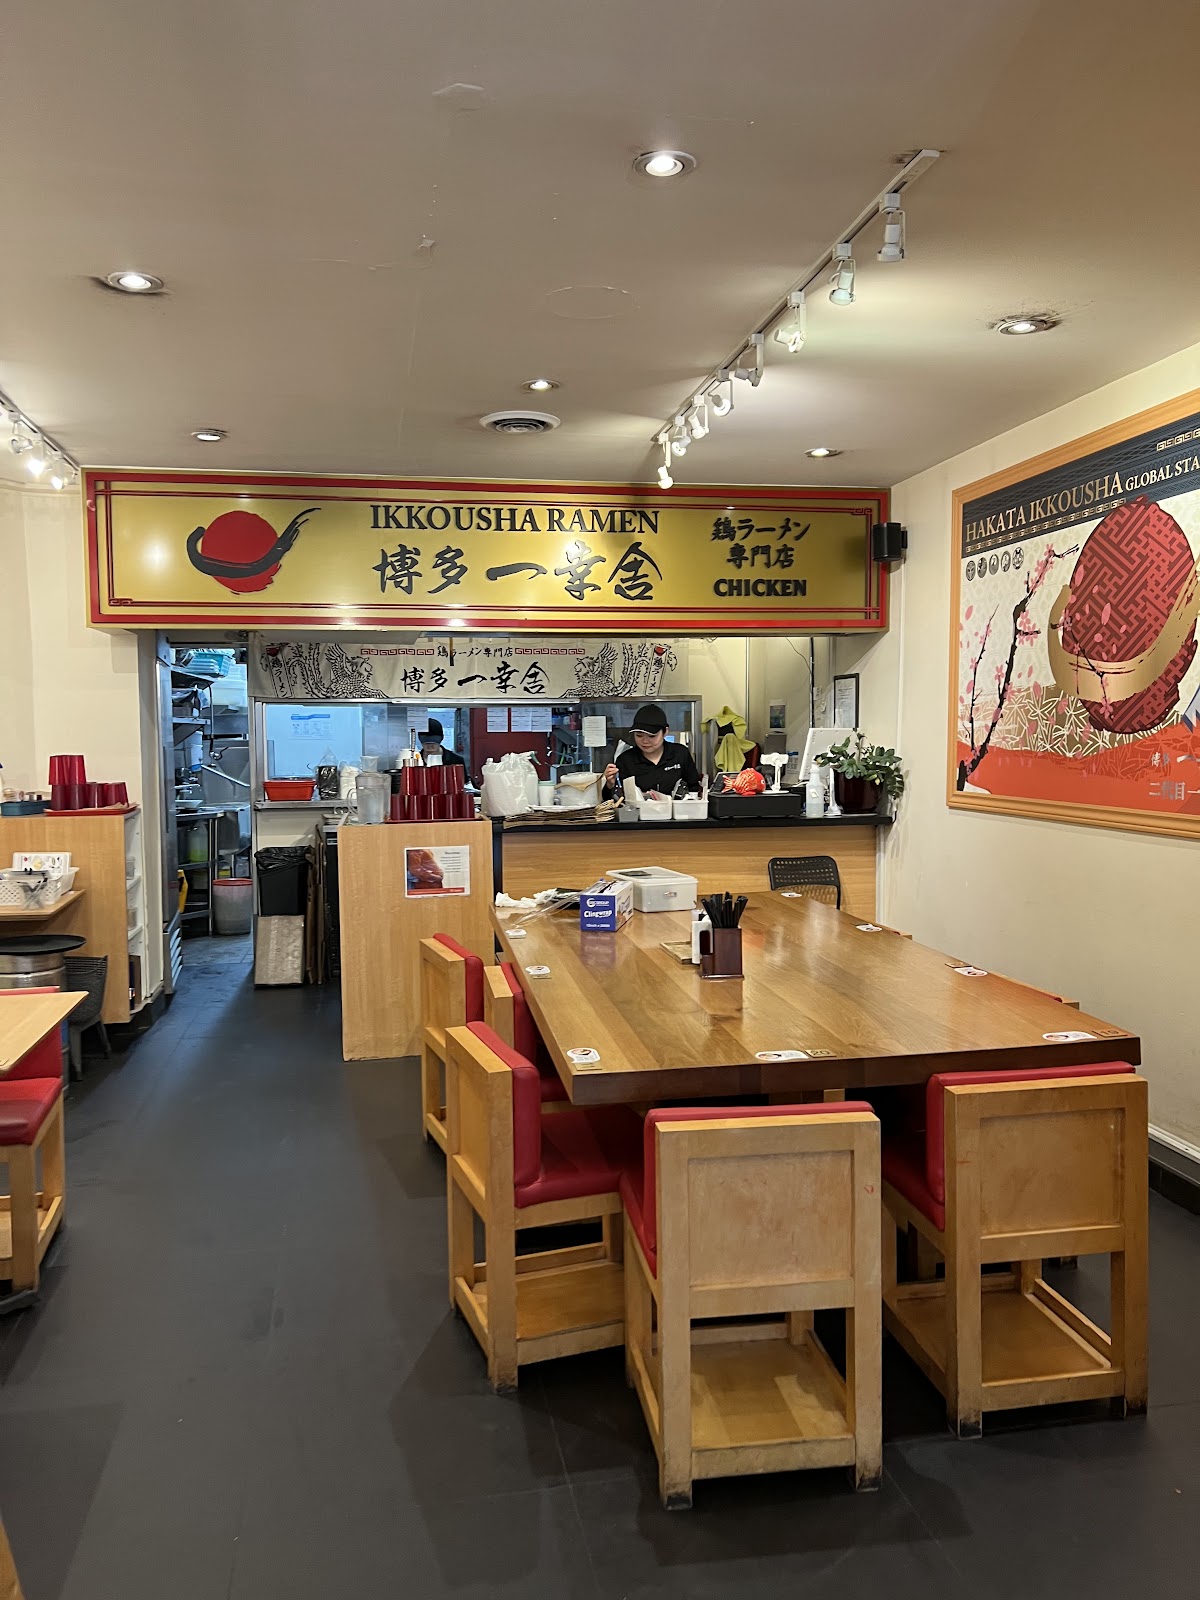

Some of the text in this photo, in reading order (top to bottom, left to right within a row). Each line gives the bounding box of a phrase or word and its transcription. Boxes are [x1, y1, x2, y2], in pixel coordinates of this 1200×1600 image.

[966, 505, 1026, 542] HAKATA
[1029, 471, 1123, 522] IKKOUSHA
[1125, 464, 1173, 491] GLOBAL
[369, 504, 660, 534] IKKOUSHA RAMEN
[711, 517, 811, 541] 鶏ラーメン
[726, 543, 795, 569] 専門店
[713, 578, 807, 597] CHICKEN
